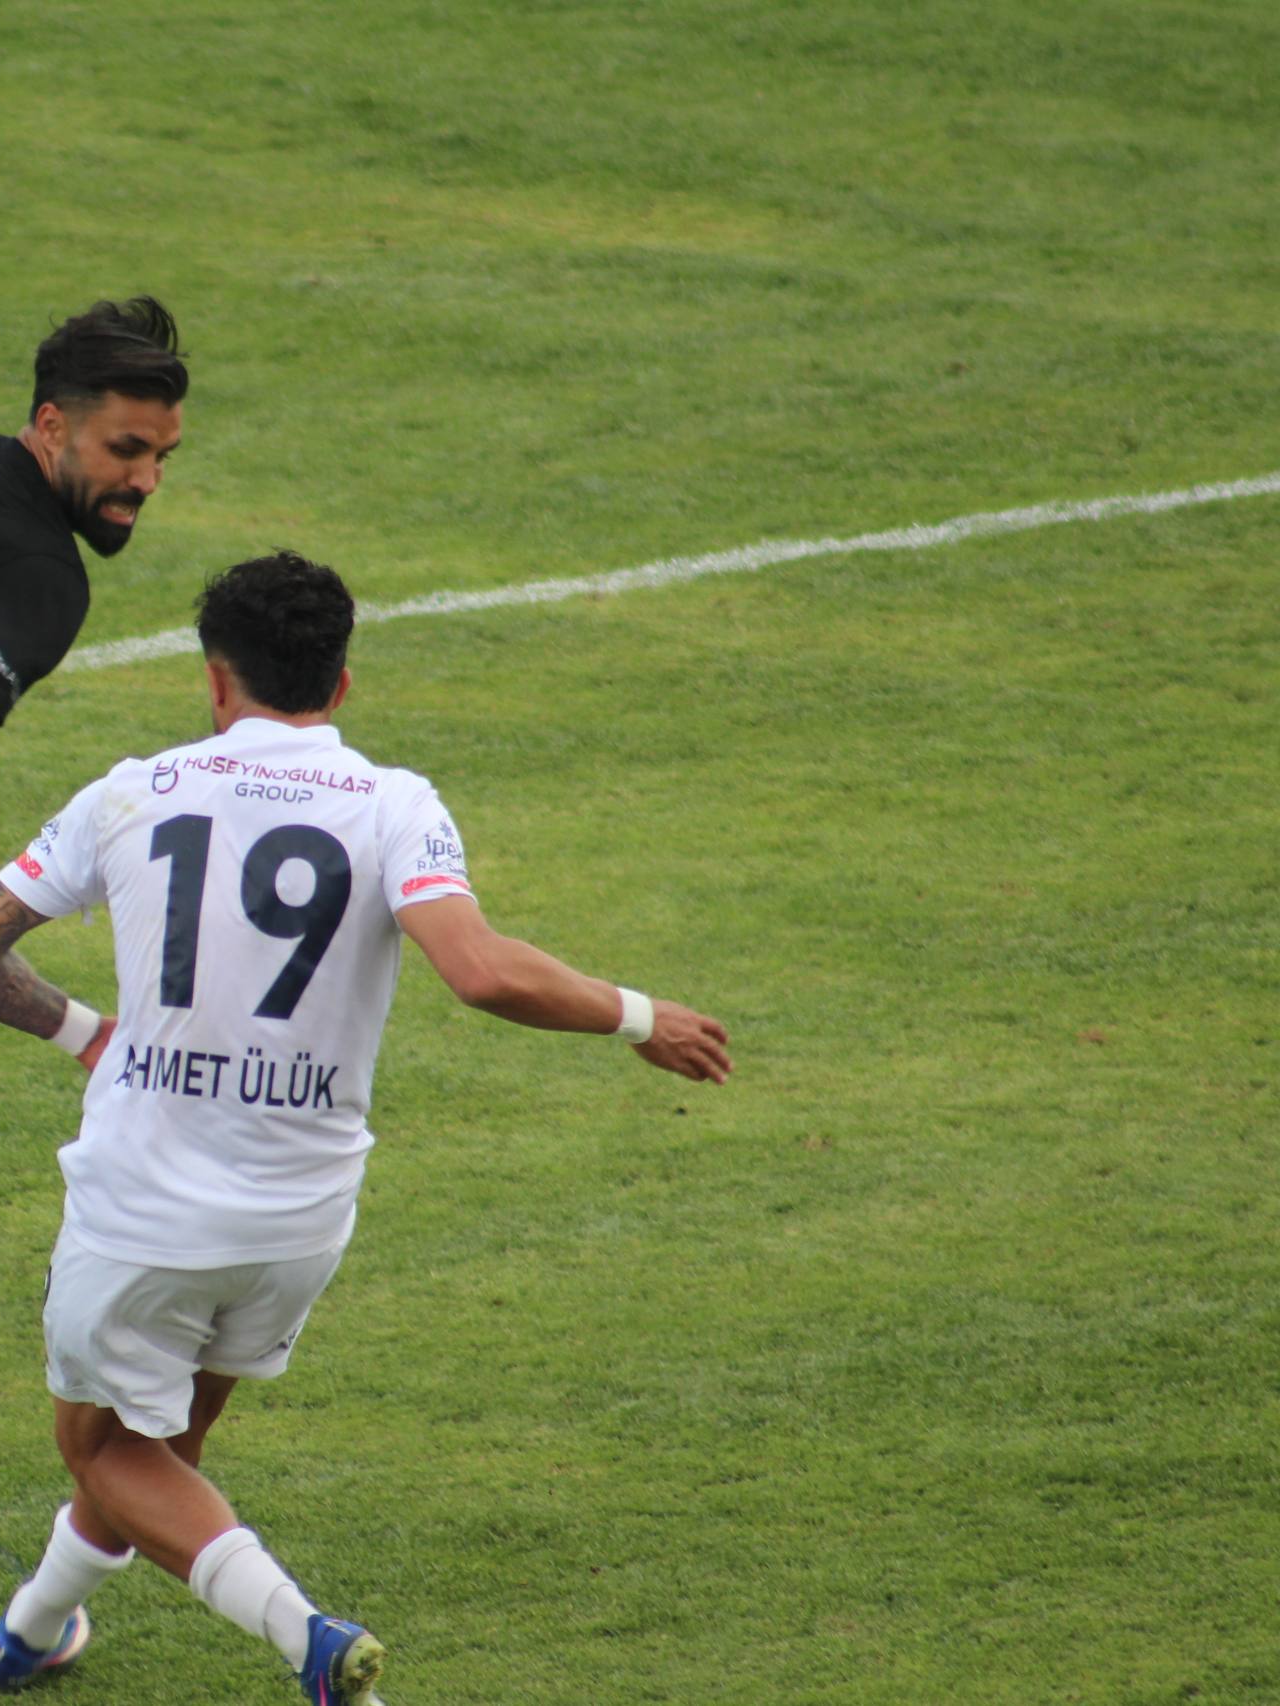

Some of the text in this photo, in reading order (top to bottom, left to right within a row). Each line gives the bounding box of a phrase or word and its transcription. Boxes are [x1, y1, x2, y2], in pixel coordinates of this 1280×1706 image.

[234, 782, 314, 804] GROUP
[424, 833, 462, 861] ipe
[148, 813, 352, 1020] 19
[114, 1044, 339, 1109] AHMET ÜLÜK
